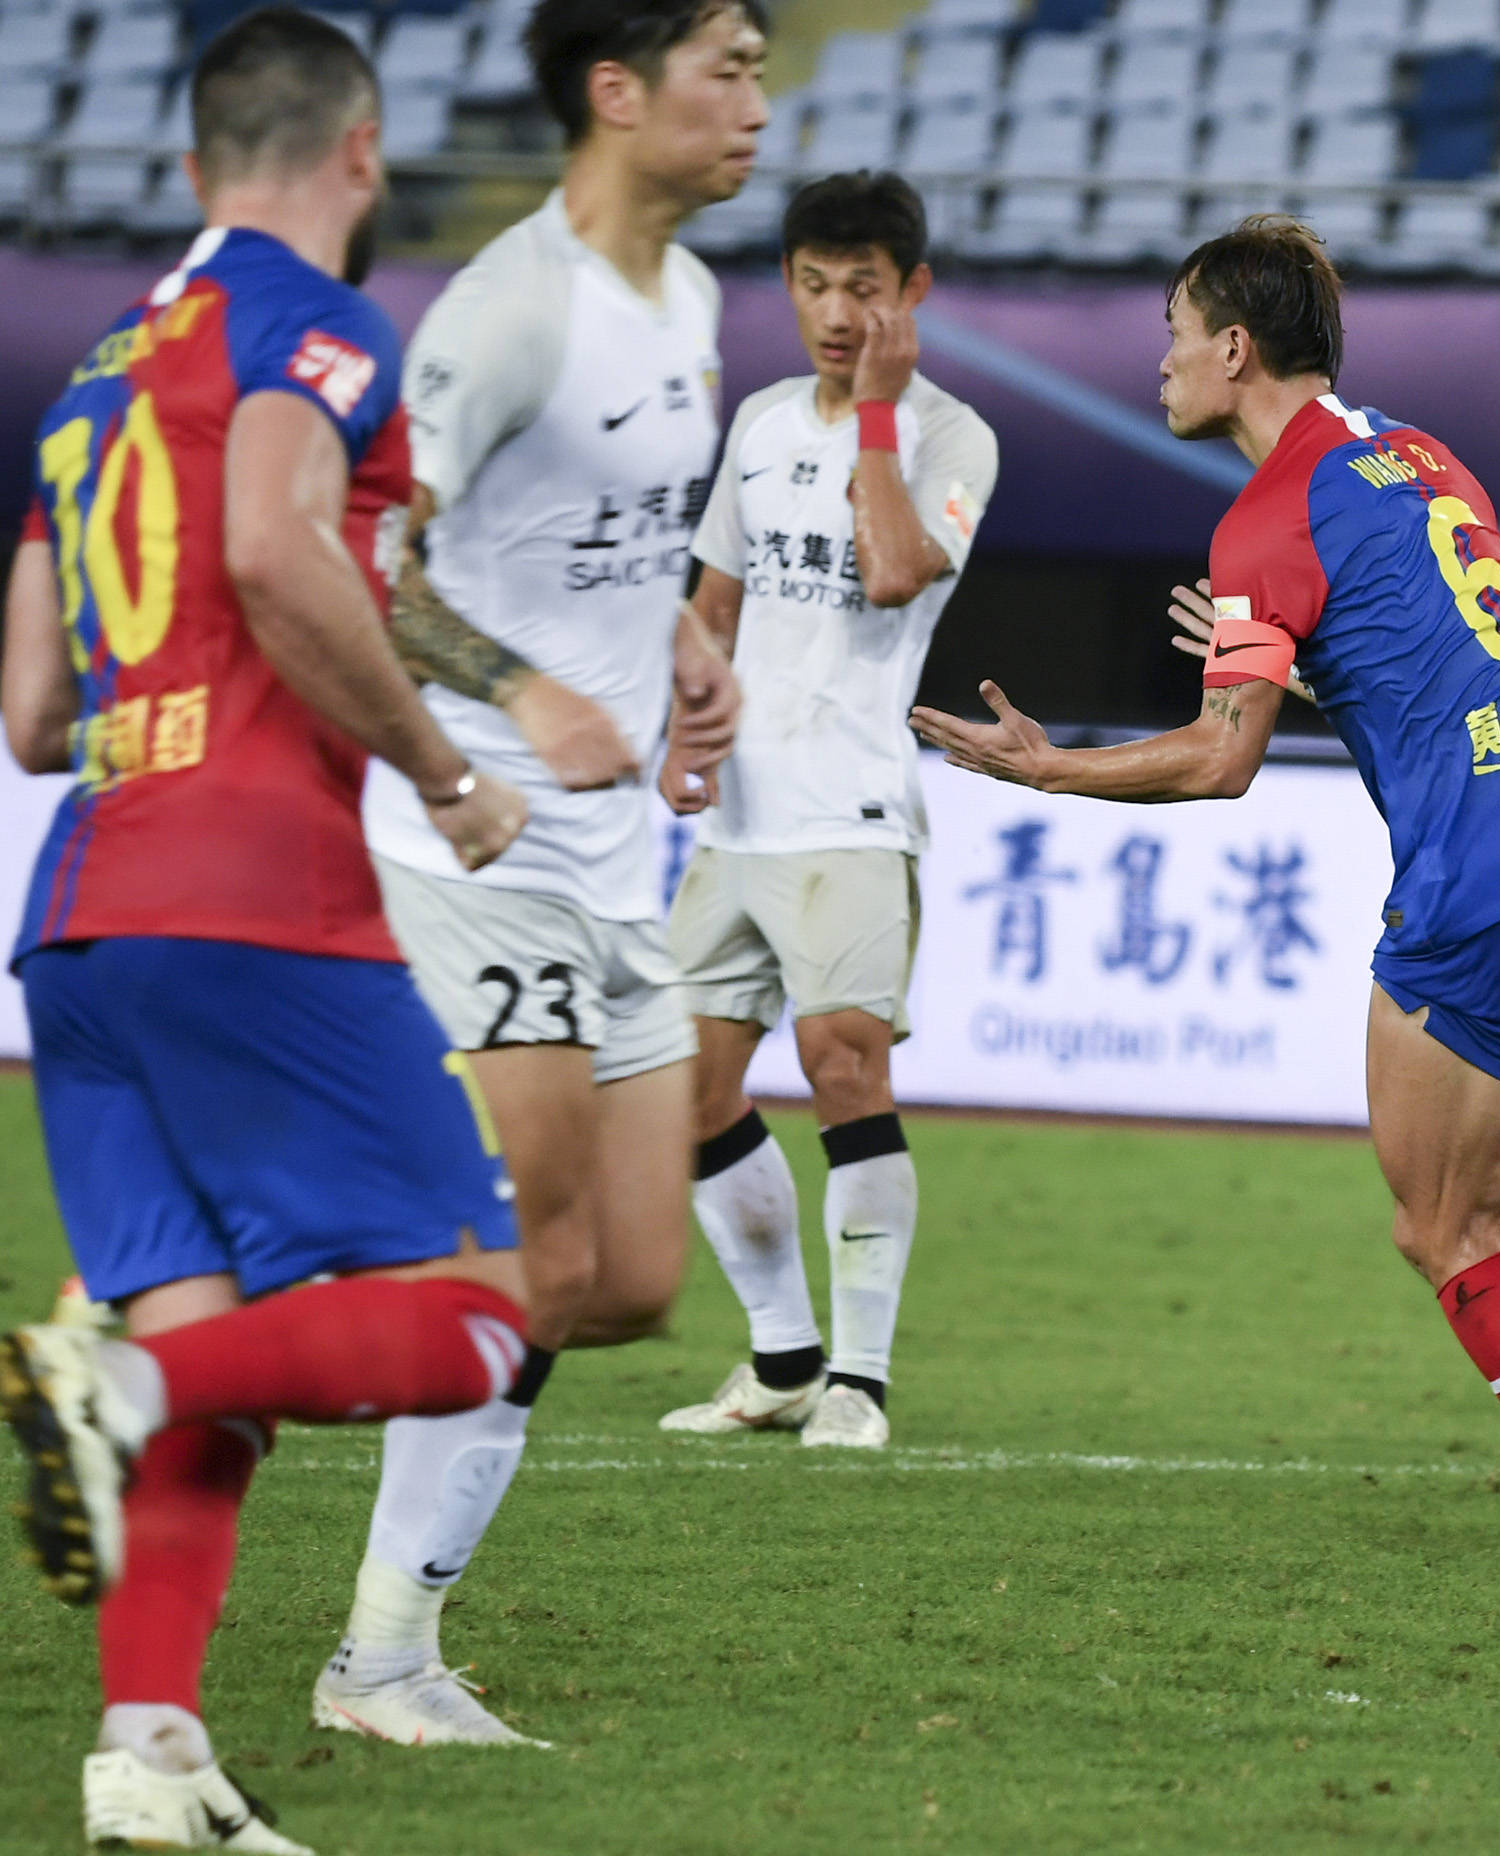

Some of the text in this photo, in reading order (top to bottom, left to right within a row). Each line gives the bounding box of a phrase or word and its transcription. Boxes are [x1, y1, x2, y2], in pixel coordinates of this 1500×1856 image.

[1347, 449, 1417, 489] WANG
[40, 391, 180, 673] 10
[476, 964, 580, 1050] 23
[1180, 1014, 1277, 1062] Port
